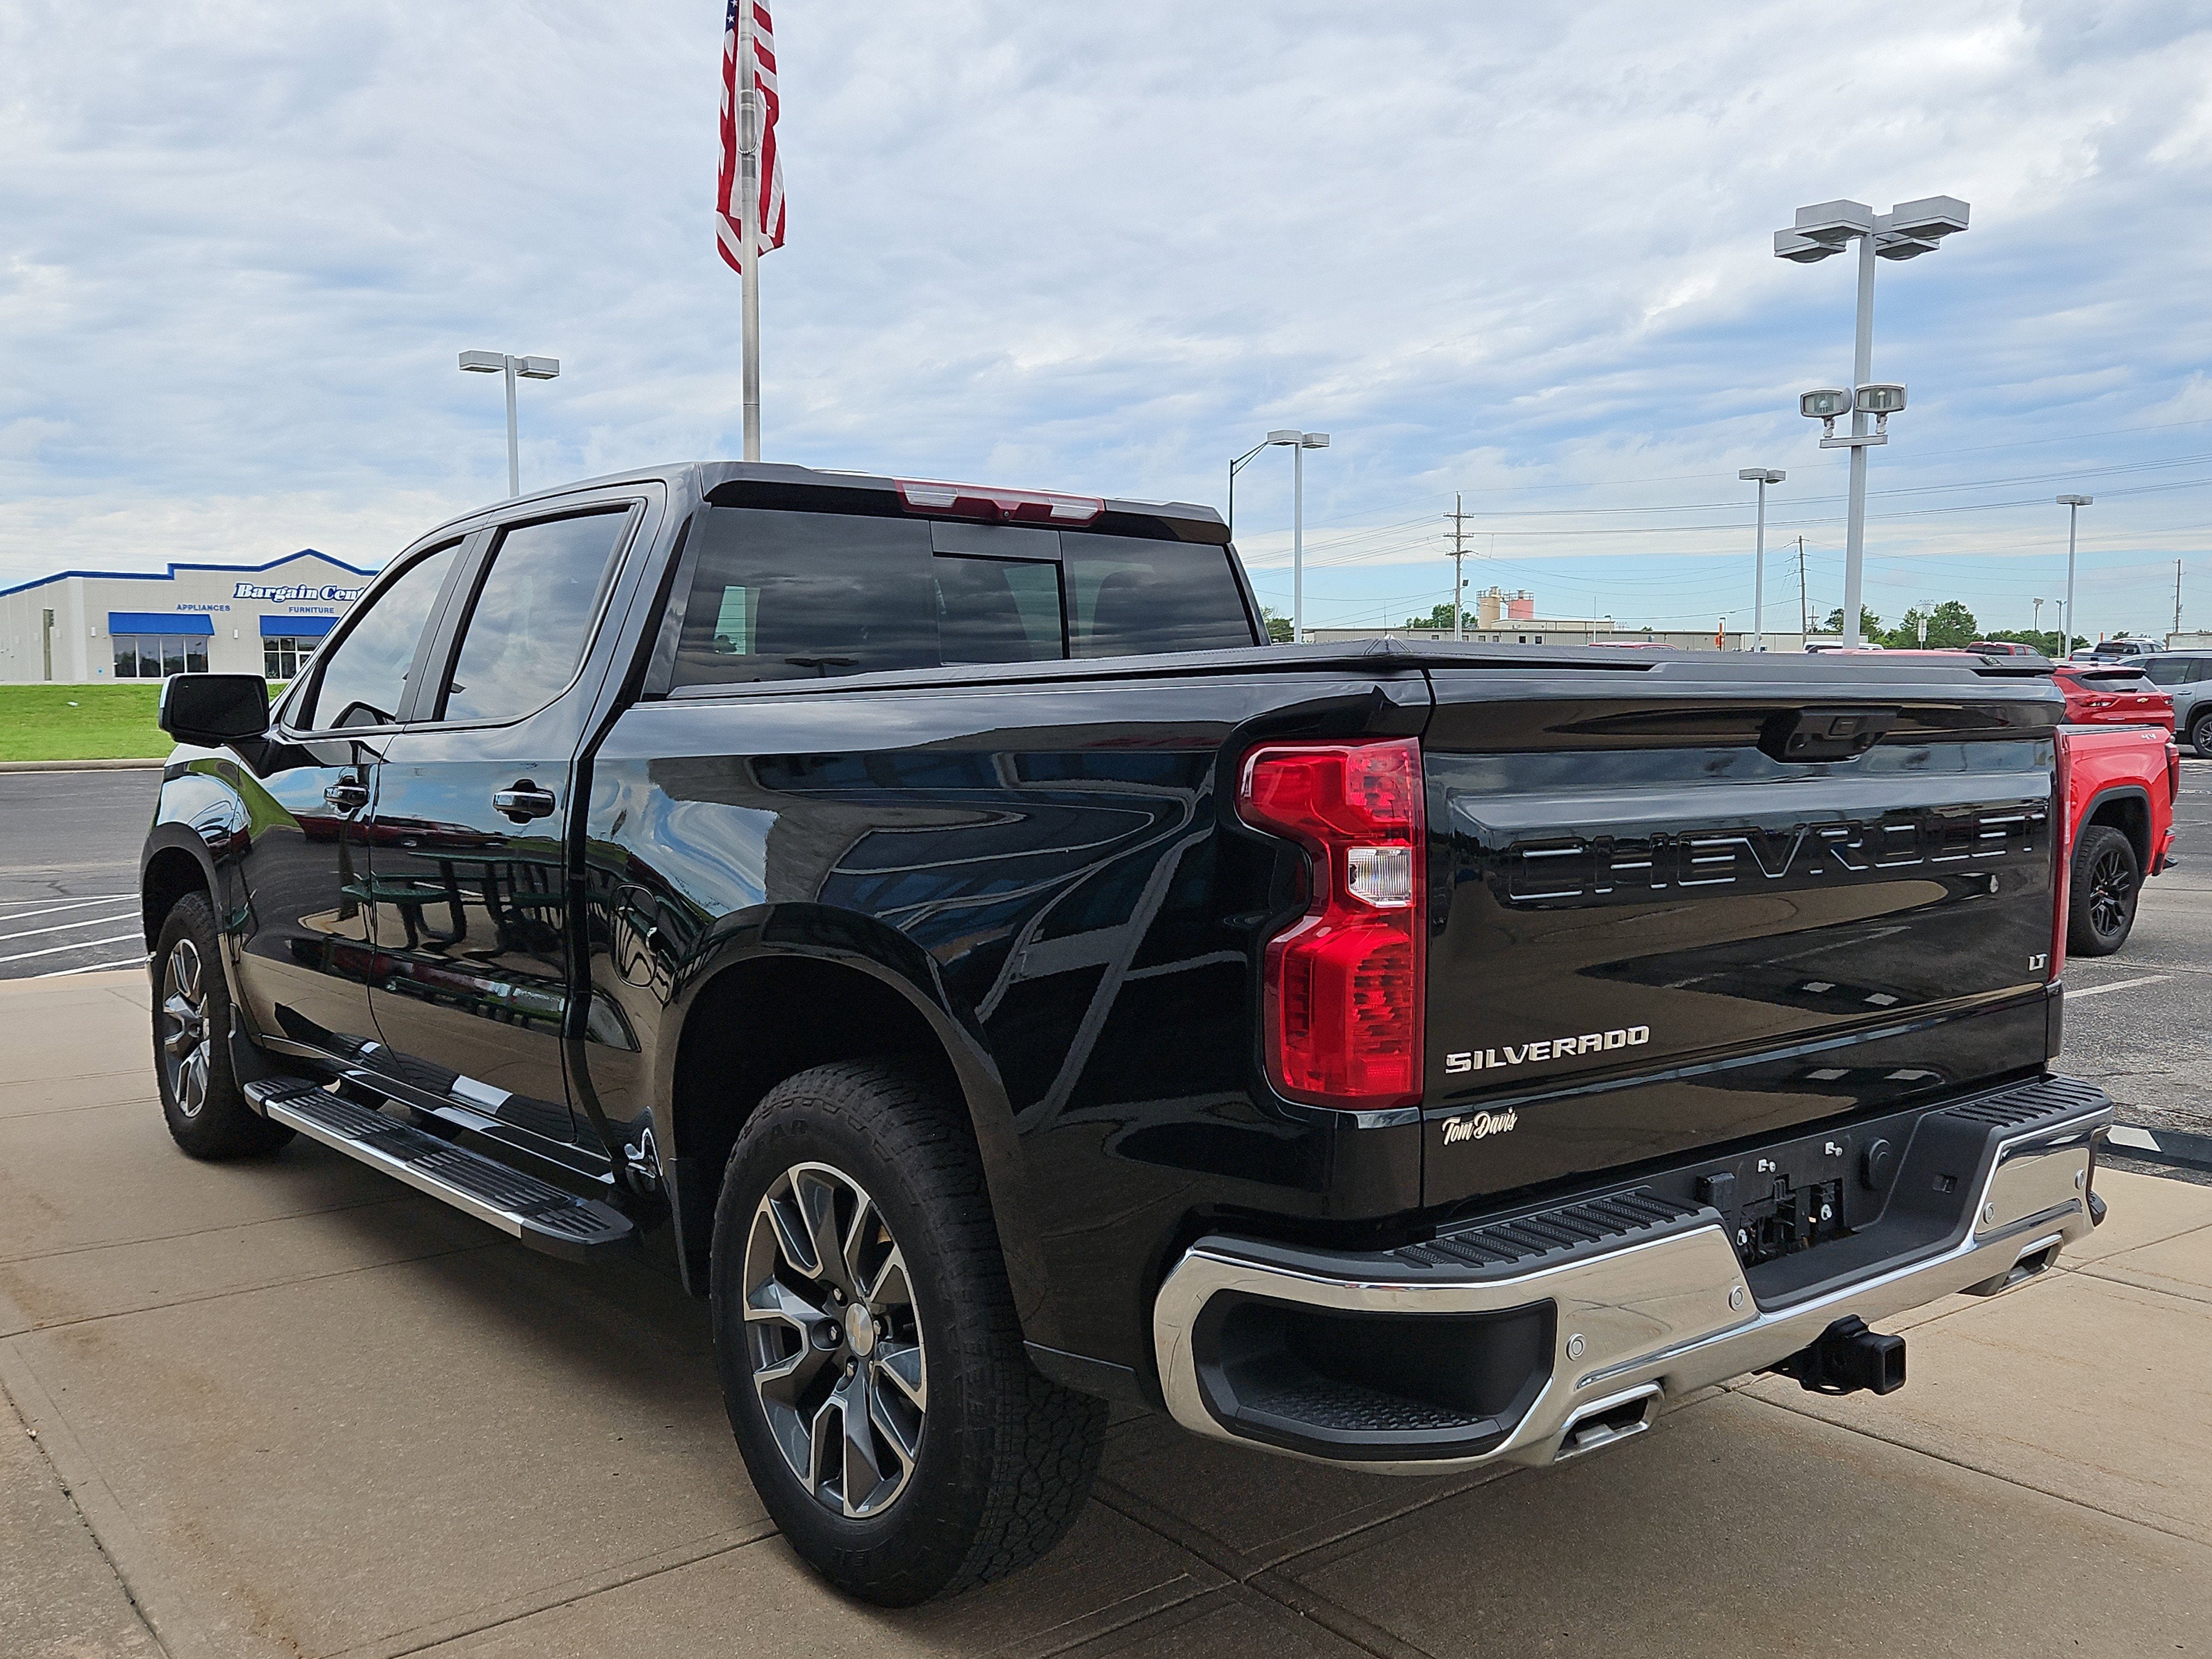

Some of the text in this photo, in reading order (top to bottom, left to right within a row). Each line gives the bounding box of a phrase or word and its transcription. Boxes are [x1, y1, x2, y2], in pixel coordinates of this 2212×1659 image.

[234, 583, 318, 602] Bargain
[1509, 806, 2046, 900] CHEVROLET
[2028, 953, 2048, 970] LT
[1445, 1025, 1650, 1073] SILVERADO
[1442, 1107, 1519, 1146] Tom Davis
